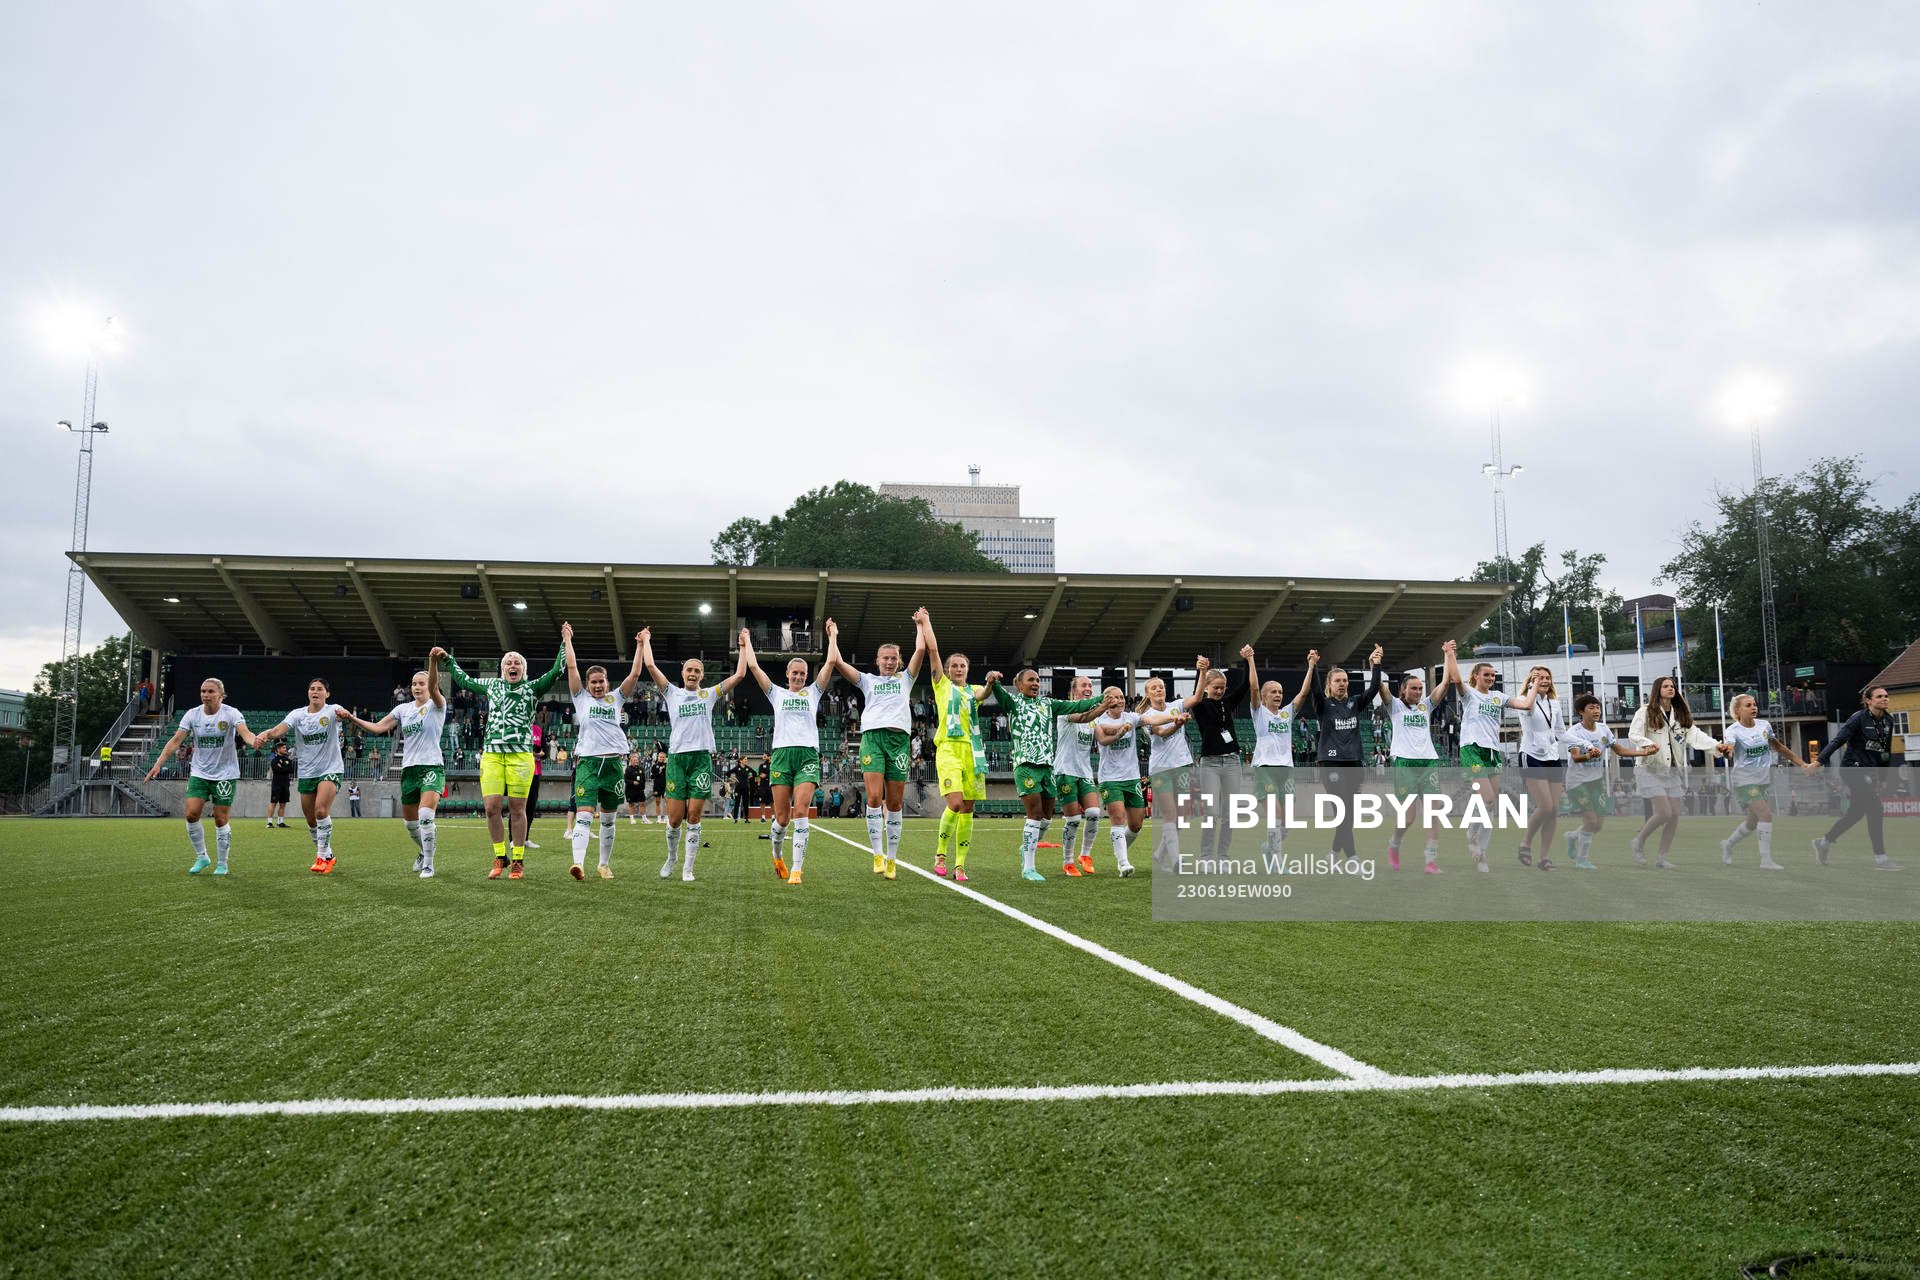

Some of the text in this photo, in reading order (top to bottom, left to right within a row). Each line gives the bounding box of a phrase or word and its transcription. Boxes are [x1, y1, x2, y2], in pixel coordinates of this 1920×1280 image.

[874, 683, 901, 691] HUSKI
[782, 698, 809, 706] HUSKI
[589, 706, 616, 716] HUSKI
[679, 703, 707, 714] HUSKI
[197, 735, 225, 745] HUSKI
[1328, 749, 1337, 757] 23
